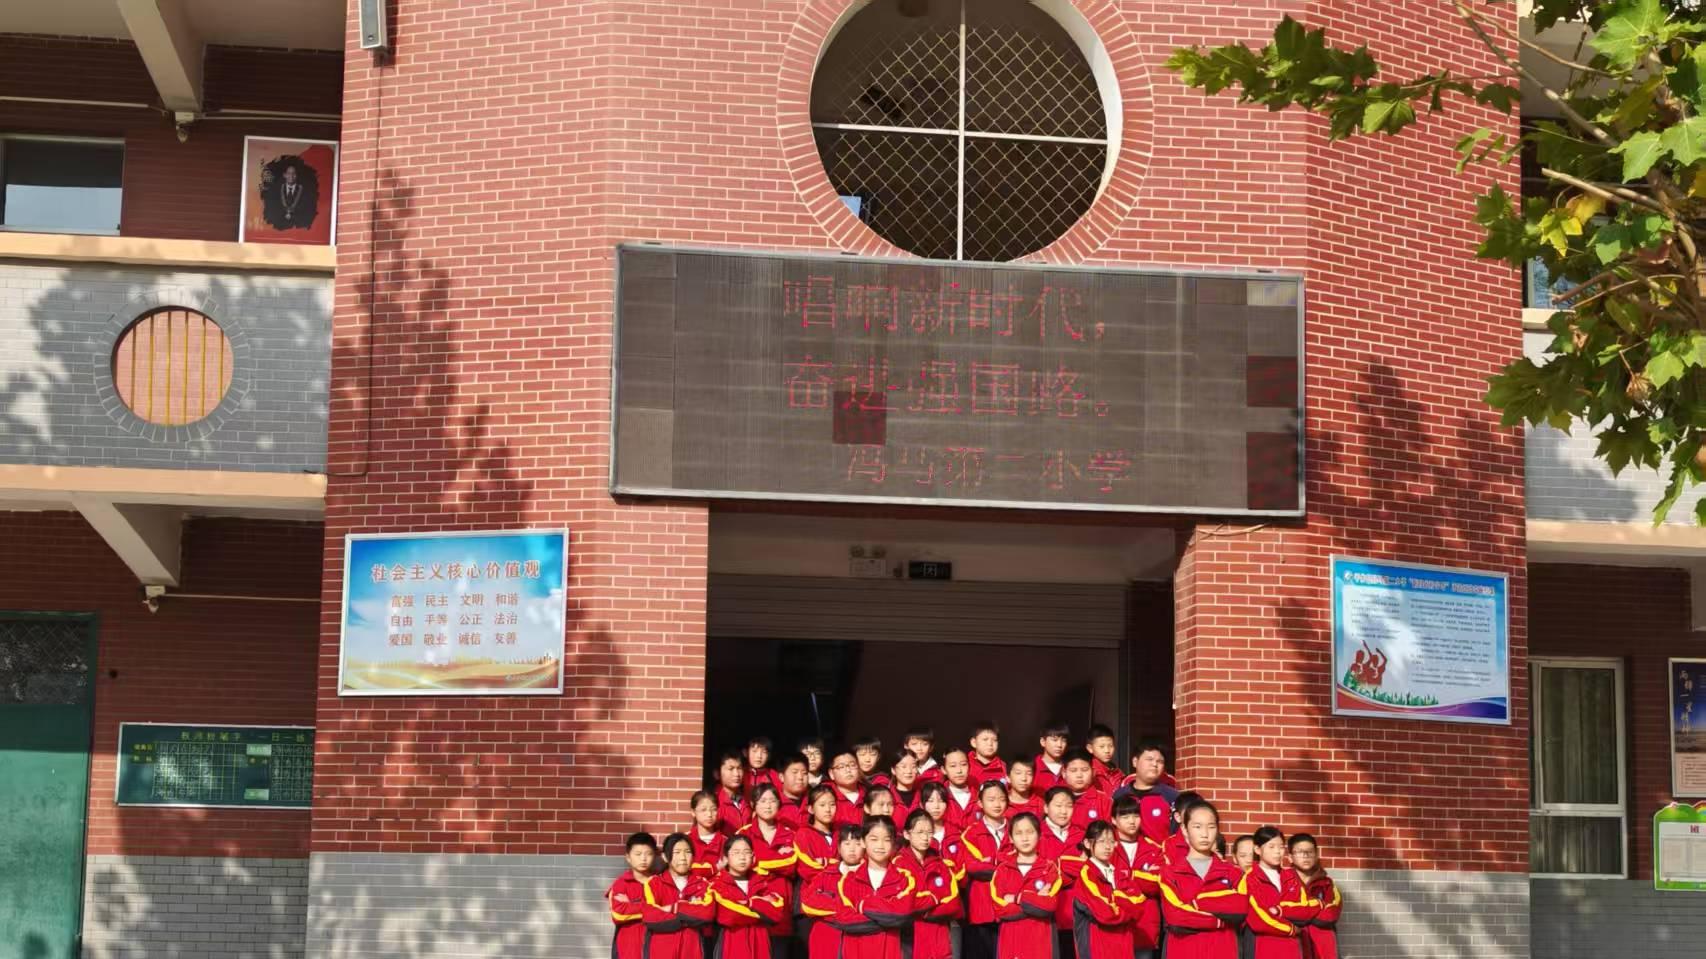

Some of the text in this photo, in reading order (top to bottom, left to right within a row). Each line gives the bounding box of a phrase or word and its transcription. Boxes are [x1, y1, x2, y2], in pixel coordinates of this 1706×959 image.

[372, 559, 541, 581] 社会主义核心价值观
[391, 592, 520, 608] 富强 民主 文明 和谐
[391, 612, 518, 627] 自由 平等 公正 法治
[389, 632, 518, 646] 爱国 敬业 诚信 友善
